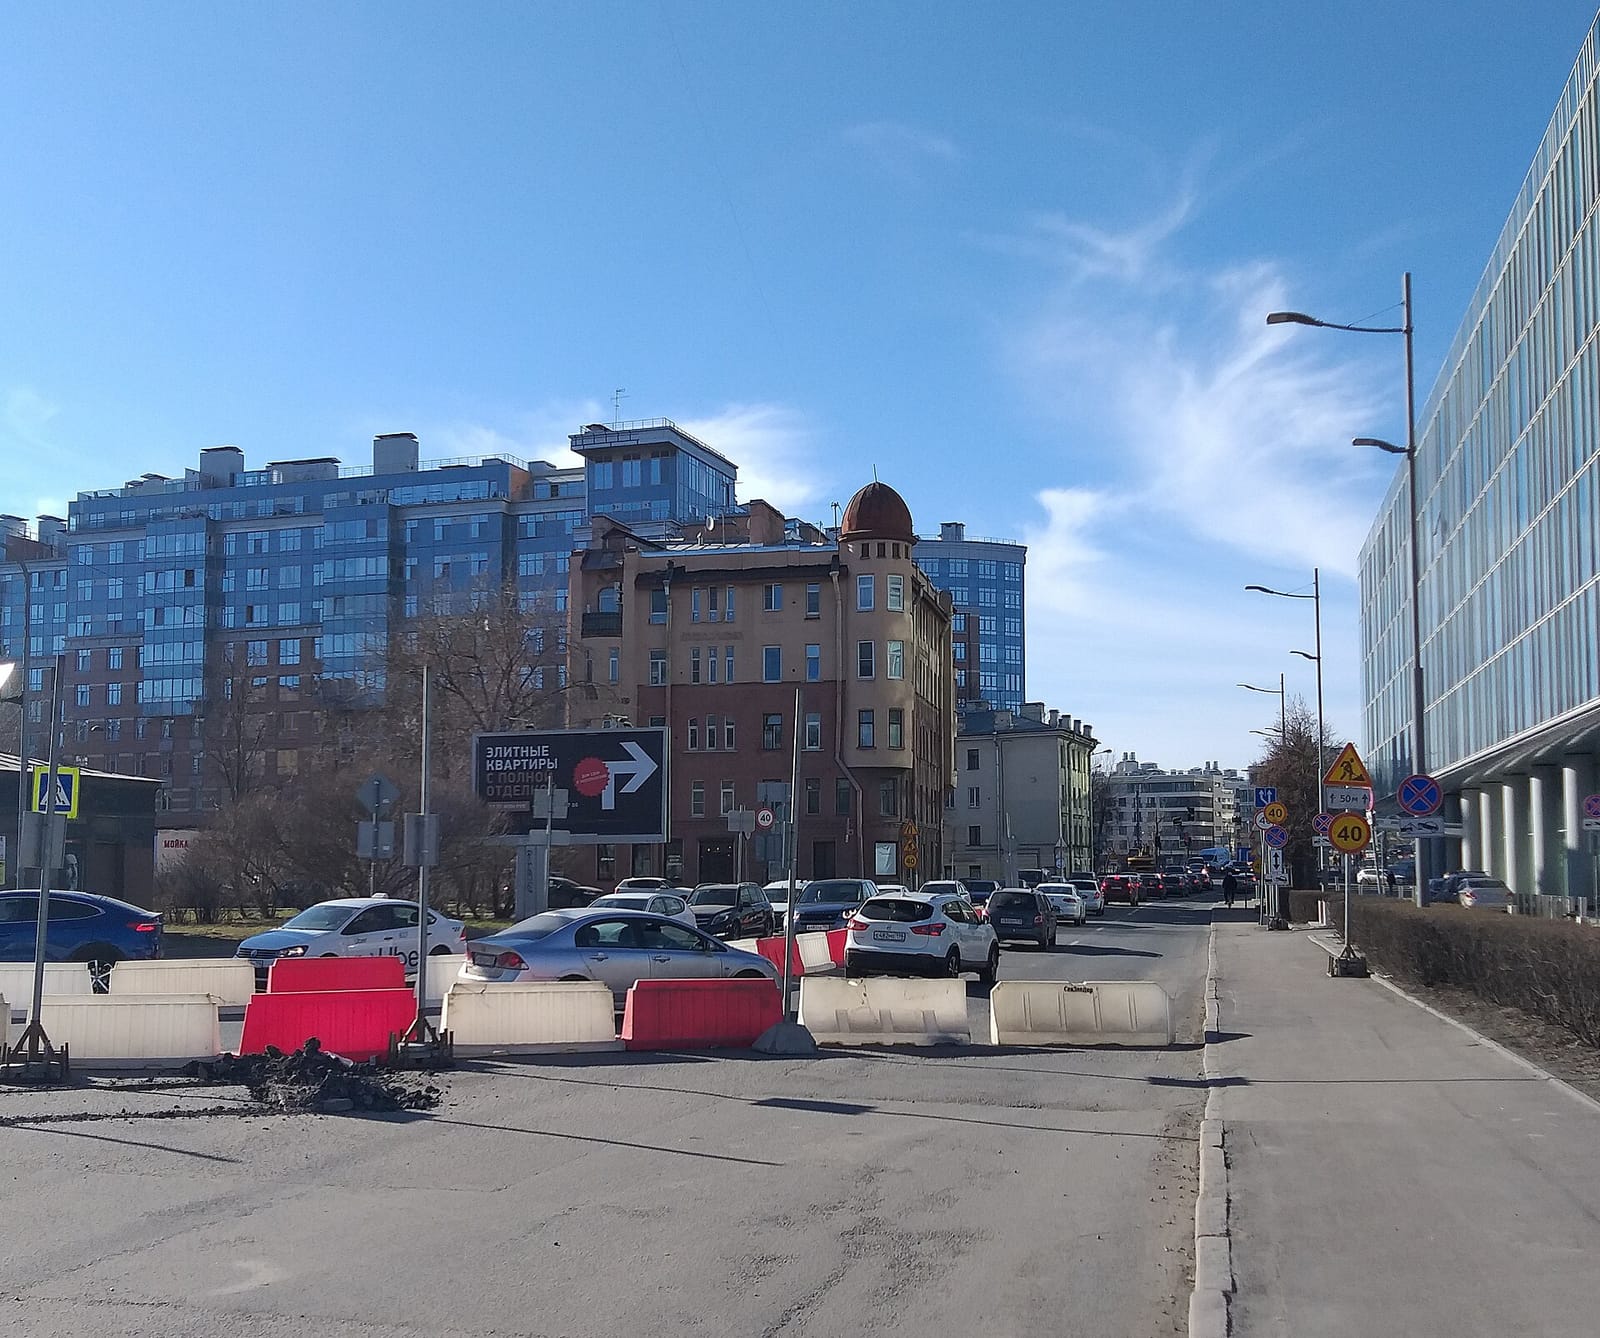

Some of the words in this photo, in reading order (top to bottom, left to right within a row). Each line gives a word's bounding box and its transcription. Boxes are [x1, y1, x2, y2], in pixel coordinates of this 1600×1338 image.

[486, 745, 549, 758] ЭЛИТНЫЕ
[486, 758, 558, 771] КВАРТИРЫ
[487, 773, 494, 784] С
[760, 813, 771, 822] 40
[1268, 808, 1282, 818] 40
[1337, 825, 1362, 842] 40
[164, 839, 188, 849] МОЙКА
